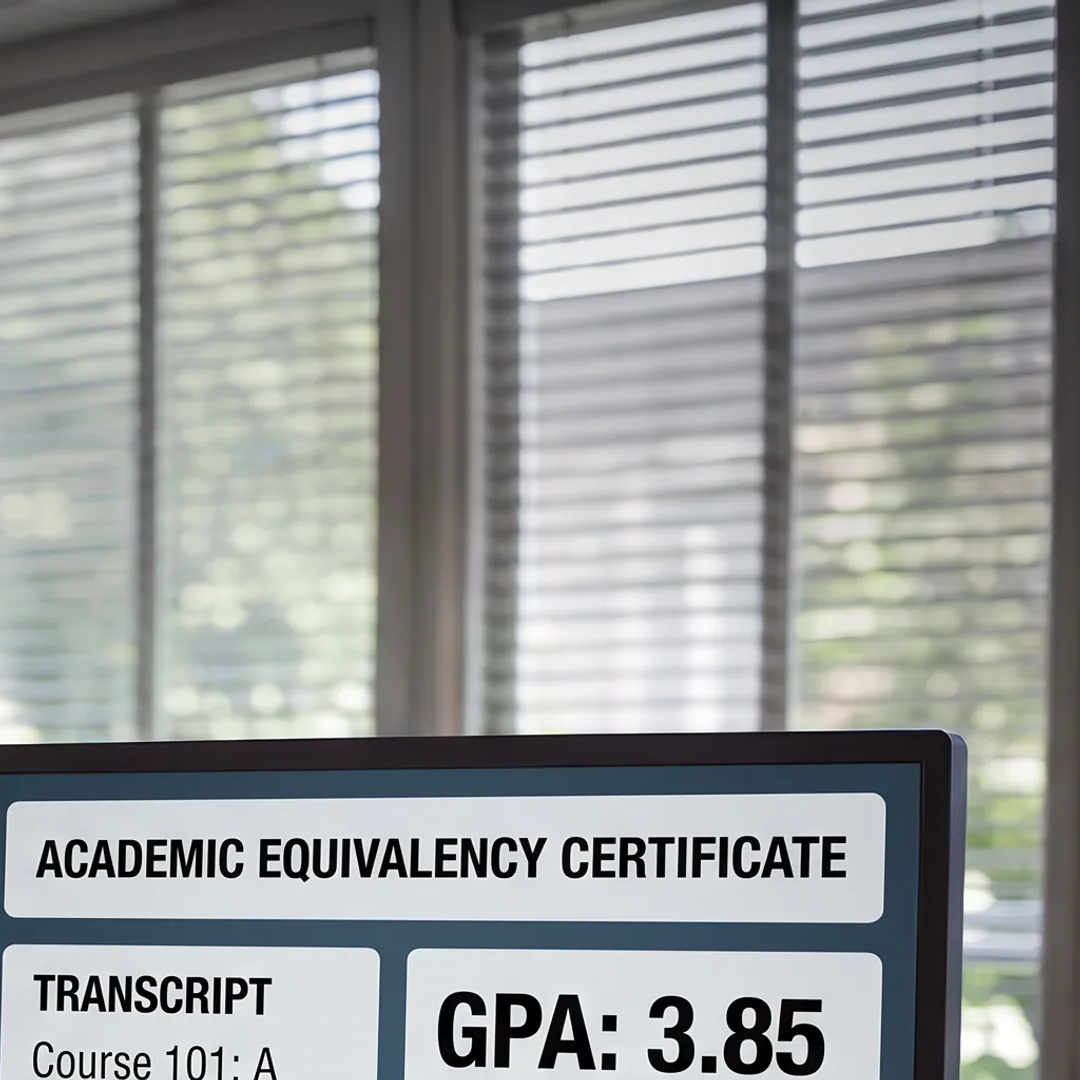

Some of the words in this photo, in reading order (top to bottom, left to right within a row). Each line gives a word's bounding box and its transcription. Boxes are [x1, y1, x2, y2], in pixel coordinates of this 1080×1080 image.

[36, 838, 243, 878] ACADEMIC
[259, 837, 547, 882] EQUIVALENCY
[562, 836, 846, 878] CERTIFICATE
[34, 975, 272, 1015] TRANSCRIPT
[438, 992, 617, 1070] GPA:
[648, 996, 824, 1076] 3.85
[33, 1042, 151, 1080] Course
